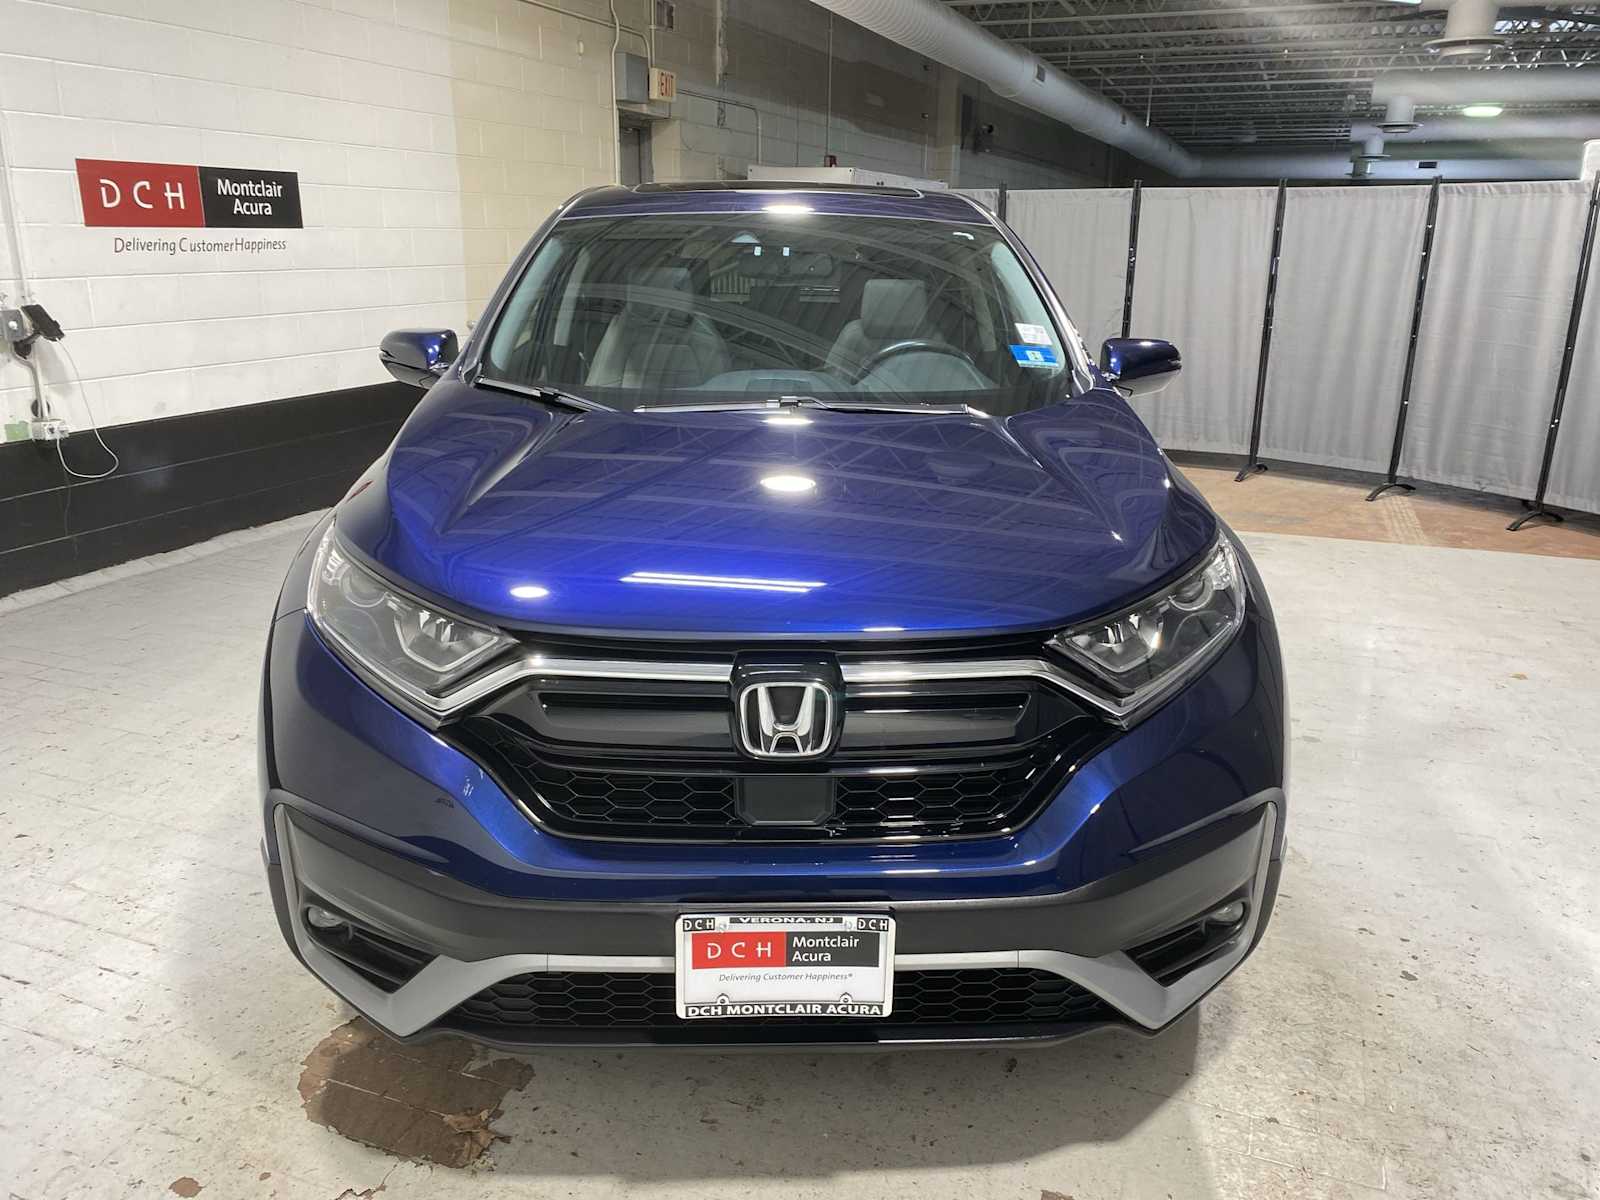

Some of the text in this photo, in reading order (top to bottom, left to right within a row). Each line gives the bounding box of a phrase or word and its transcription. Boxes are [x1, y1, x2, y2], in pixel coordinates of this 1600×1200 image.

[660, 72, 673, 97] EXIT
[99, 178, 185, 210] DCH
[217, 178, 283, 198] Montclair
[233, 199, 273, 216] Acura
[114, 237, 176, 256] Delivering
[684, 919, 714, 930] DCH
[858, 919, 888, 930] DCH
[792, 936, 859, 948] Montclair
[706, 942, 773, 959] DCH
[792, 951, 832, 962] Acura
[719, 972, 762, 983] Delivering
[763, 972, 804, 982] Customer
[688, 1003, 882, 1016] DCH MONTCLAIR ACURA
